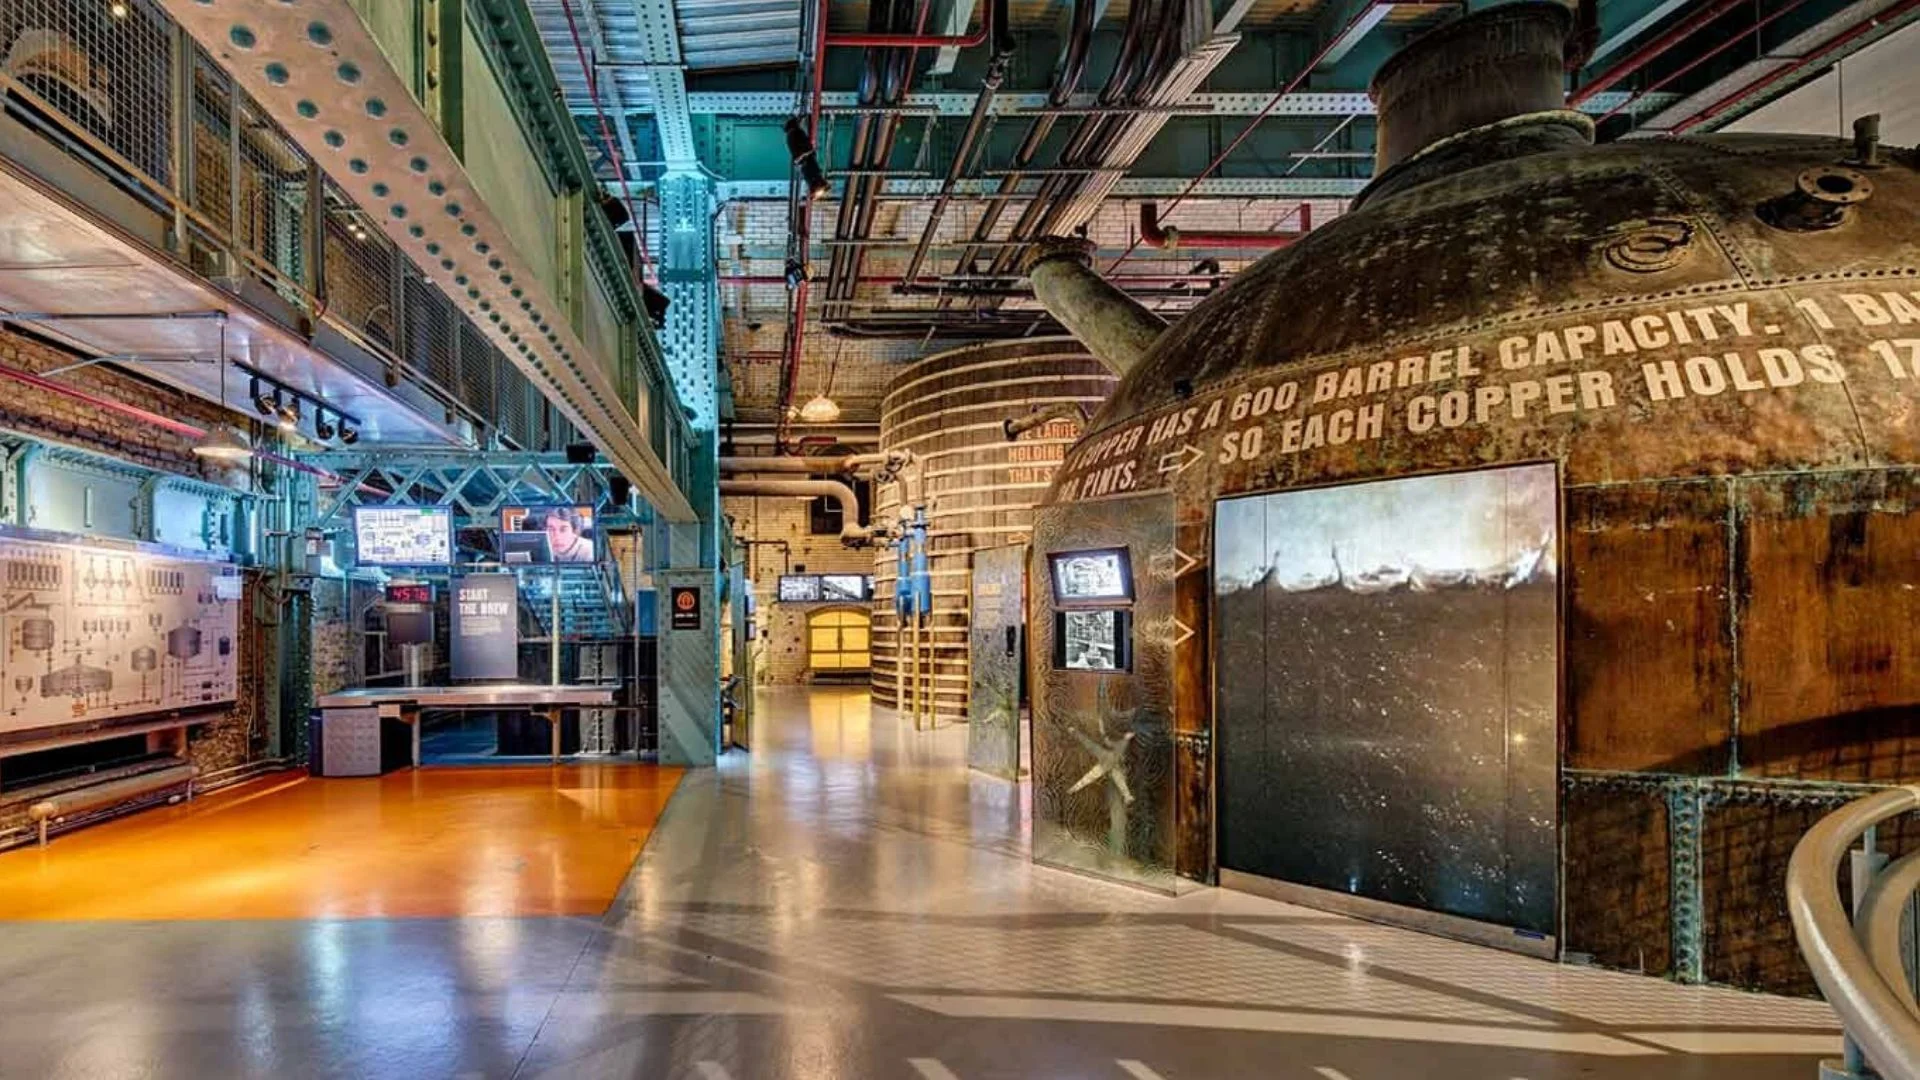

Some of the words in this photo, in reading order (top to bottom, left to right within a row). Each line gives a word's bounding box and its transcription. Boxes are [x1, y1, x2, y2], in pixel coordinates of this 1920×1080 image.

[1146, 409, 1194, 445] HAS
[1201, 404, 1220, 430] A
[1230, 381, 1298, 421] 600
[1313, 346, 1480, 403] BARREL
[1499, 302, 1780, 370] CAPACITY.
[1795, 298, 1834, 329] 1
[1840, 291, 1920, 325] BA
[1218, 426, 1261, 464] SO
[1281, 403, 1383, 454] EACH
[1407, 370, 1615, 433] COPPER
[1641, 344, 1846, 402] HOLDS
[1008, 444, 1064, 463] HOLDING
[459, 589, 488, 601] START
[459, 602, 477, 615] THE
[480, 602, 509, 615] BREW
